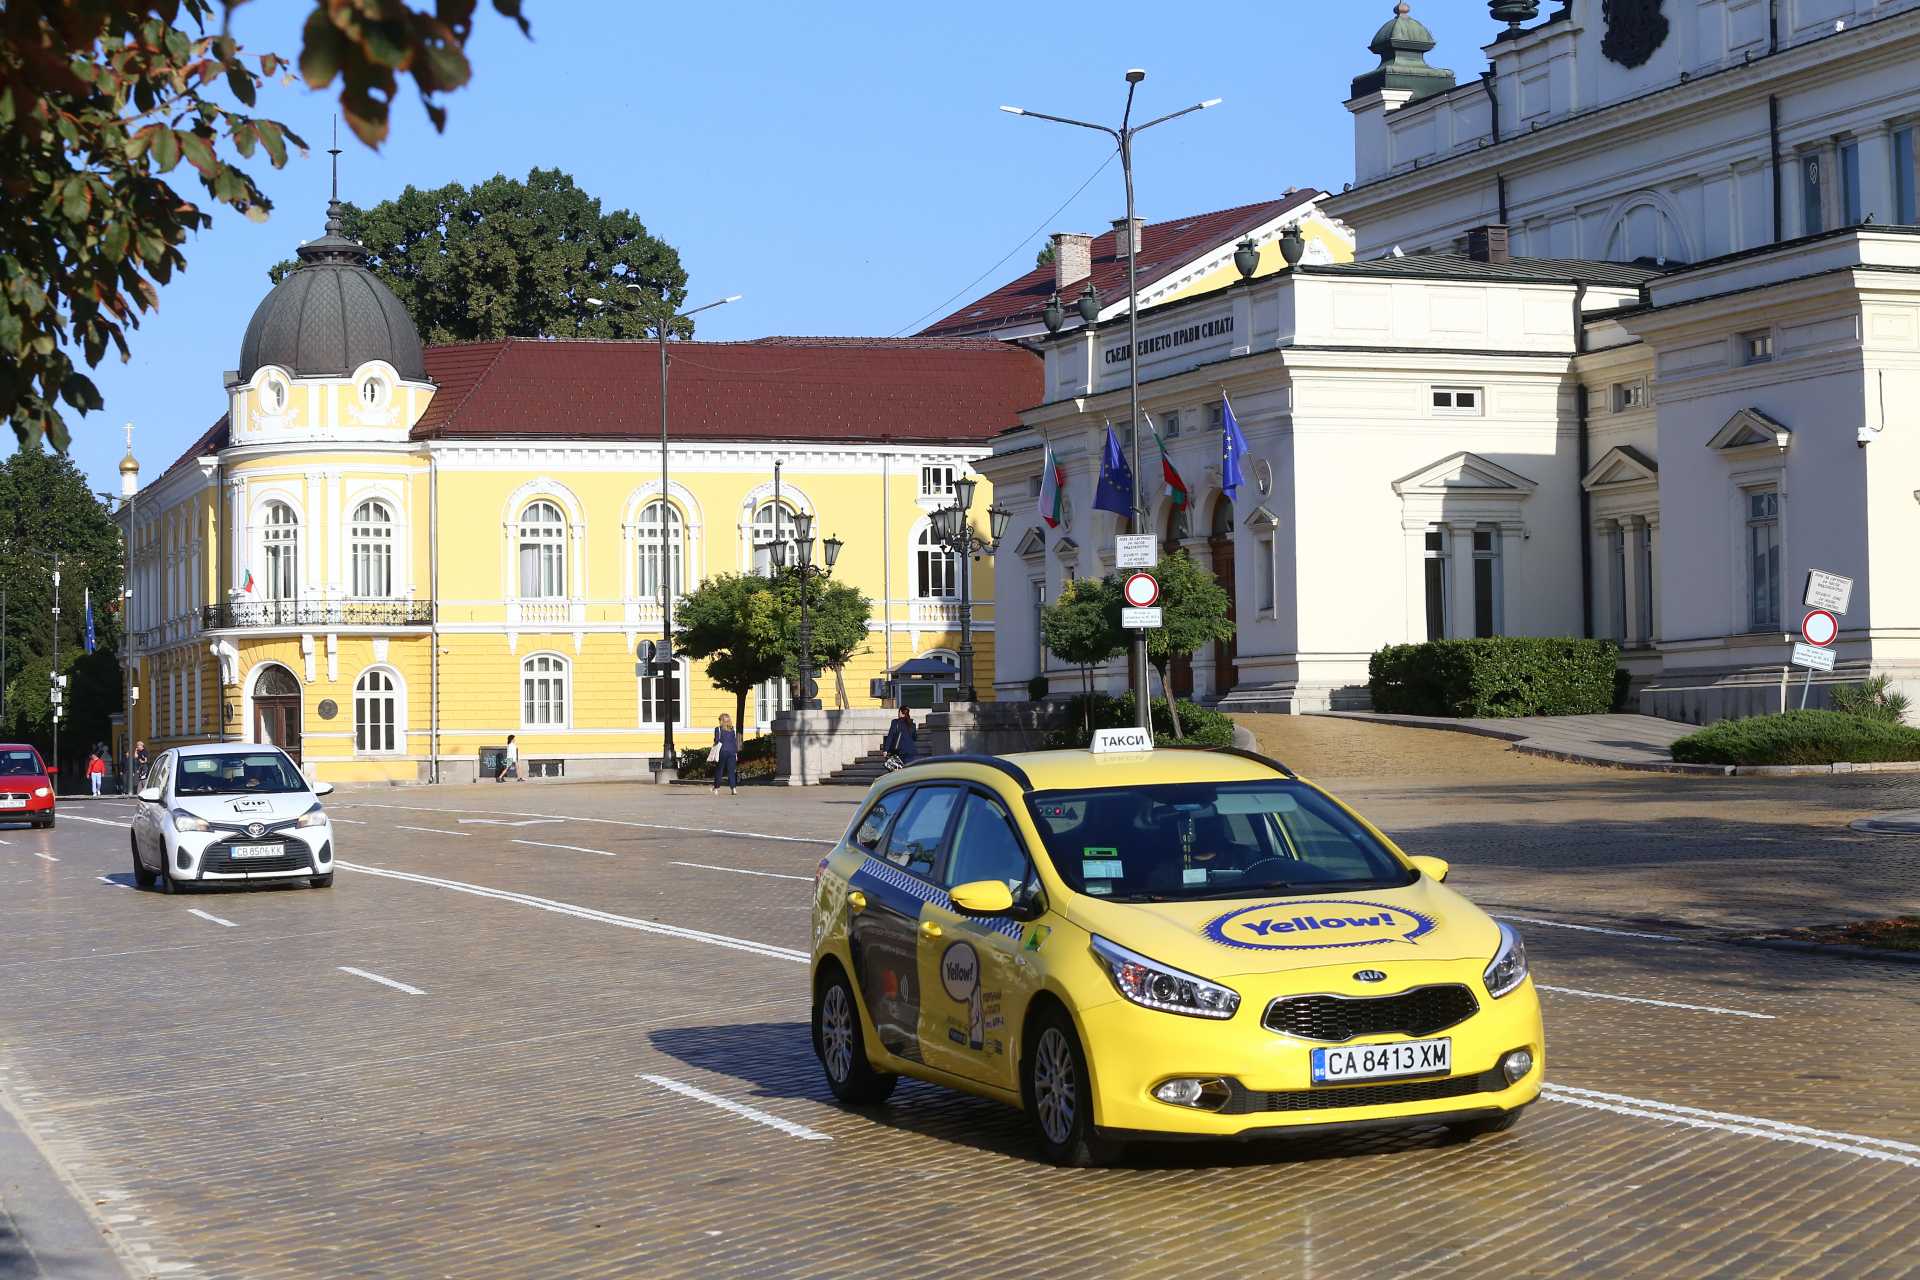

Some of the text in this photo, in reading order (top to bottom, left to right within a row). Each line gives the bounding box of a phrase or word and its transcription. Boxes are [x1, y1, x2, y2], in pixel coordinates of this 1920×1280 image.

[1105, 334, 1171, 364] СЪЕДИЕНИЕТО
[1173, 325, 1200, 347] ПРАВИ
[1101, 735, 1144, 746] ТАКСИ
[237, 846, 282, 856] CB 8506 KK
[1240, 912, 1396, 936] Yellow!
[946, 962, 973, 981] Yellow!
[1358, 971, 1383, 980] KIA
[1329, 1044, 1446, 1075] CA 8413 XM
